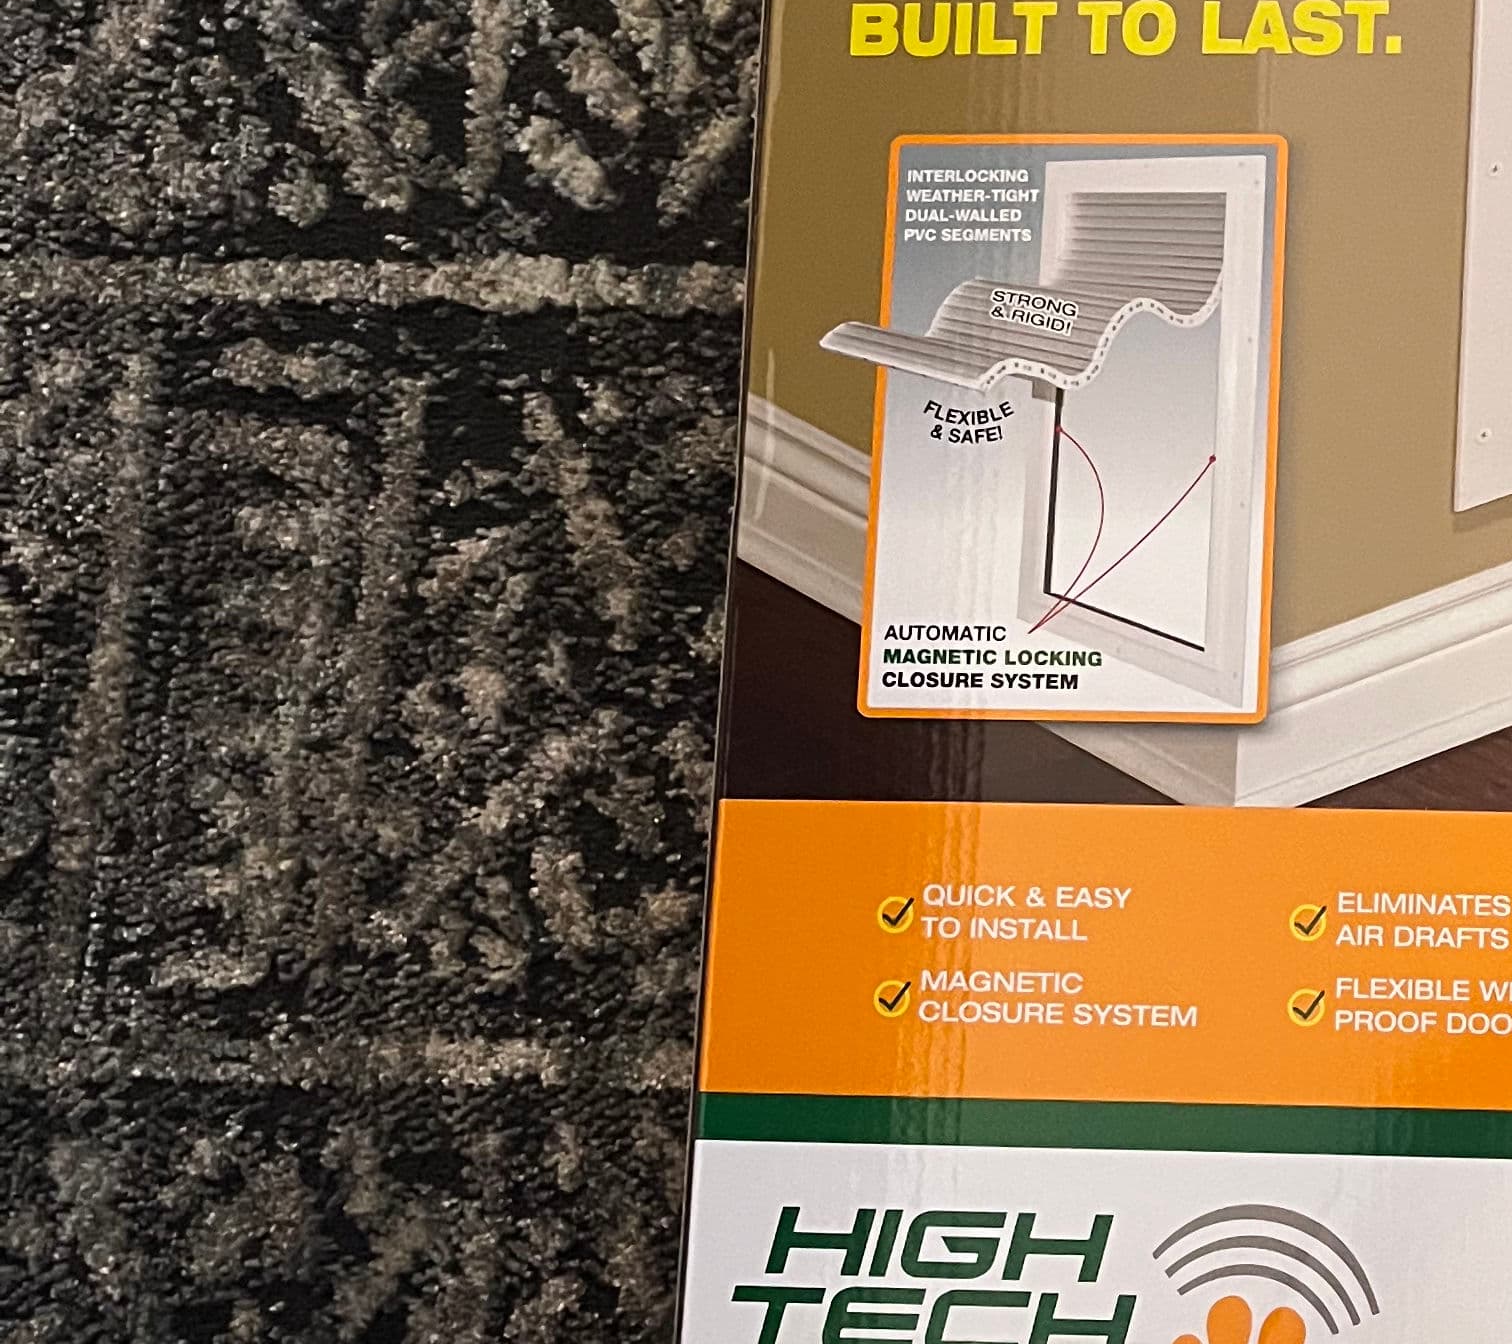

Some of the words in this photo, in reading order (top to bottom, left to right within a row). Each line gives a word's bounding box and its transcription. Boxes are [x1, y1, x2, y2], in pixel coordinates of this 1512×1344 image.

[848, 1, 1058, 57] BUILT
[1077, 0, 1177, 56] TO
[1202, 0, 1403, 55] LAST.
[907, 169, 1030, 184] INTERLOCKING
[906, 189, 1040, 204] WEATHER-TIGHT
[905, 209, 1022, 223] DUAL-WALLED
[904, 229, 937, 242] PVC
[940, 229, 1032, 242] SEGMENTS
[992, 290, 1078, 318] STRONG
[991, 305, 1005, 317] &
[1010, 309, 1072, 334] RIGID!
[923, 400, 1014, 428] FLEXIBLE
[930, 426, 944, 439] &
[947, 426, 1002, 444] SAFE!
[884, 624, 1007, 642] AUTOMATIC
[883, 649, 1000, 666] MAGNETIC
[1004, 650, 1102, 667] LOCKING
[882, 672, 984, 688] CLOSURE
[990, 673, 1079, 690] SYSTEM
[922, 885, 1015, 908] QUICK
[1024, 886, 1048, 907] &
[1055, 887, 1132, 910] EASY
[1337, 892, 1512, 917] ELIMINATES
[921, 917, 962, 940] TO
[969, 917, 1089, 941] INSTALL
[1335, 926, 1386, 948] AIR
[1392, 926, 1510, 950] DRAFTS
[920, 970, 1084, 994] MAGNETIC
[1335, 977, 1471, 1002] FLEXIBLE
[919, 1001, 1065, 1025] CLOSURE
[1072, 1002, 1198, 1027] SYSTEM
[1334, 1010, 1439, 1035] PROOF
[764, 1205, 1115, 1283] HIGH
